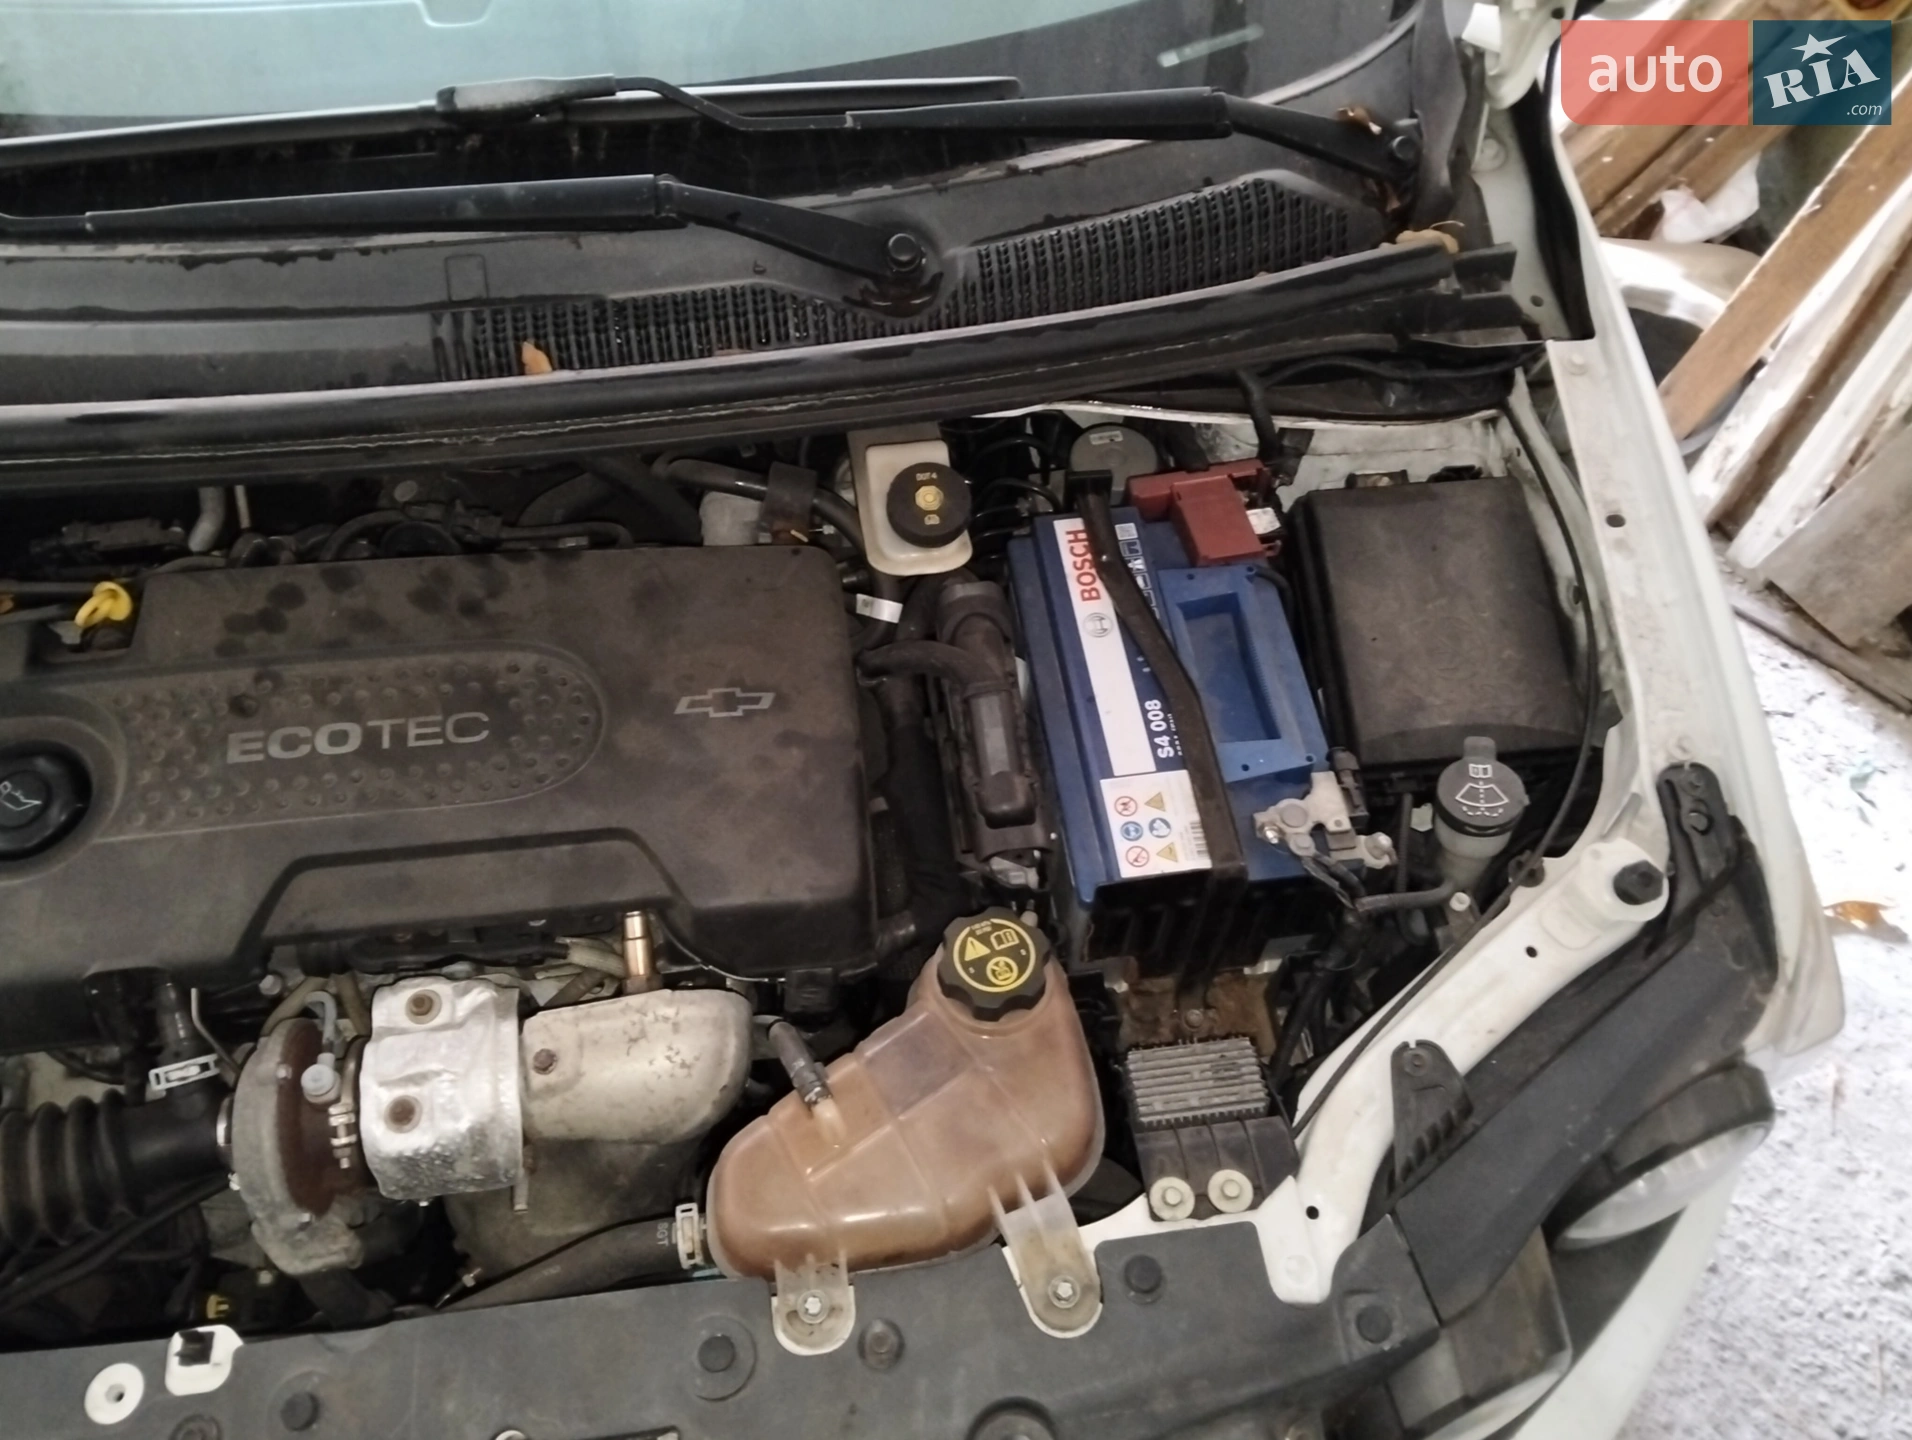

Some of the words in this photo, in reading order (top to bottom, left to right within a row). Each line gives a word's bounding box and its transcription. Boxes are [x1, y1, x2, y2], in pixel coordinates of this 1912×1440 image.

[1065, 529, 1102, 602] BOSCH
[1144, 699, 1168, 732] 008
[226, 711, 490, 765] ECOTEC
[1153, 735, 1176, 759] S4
